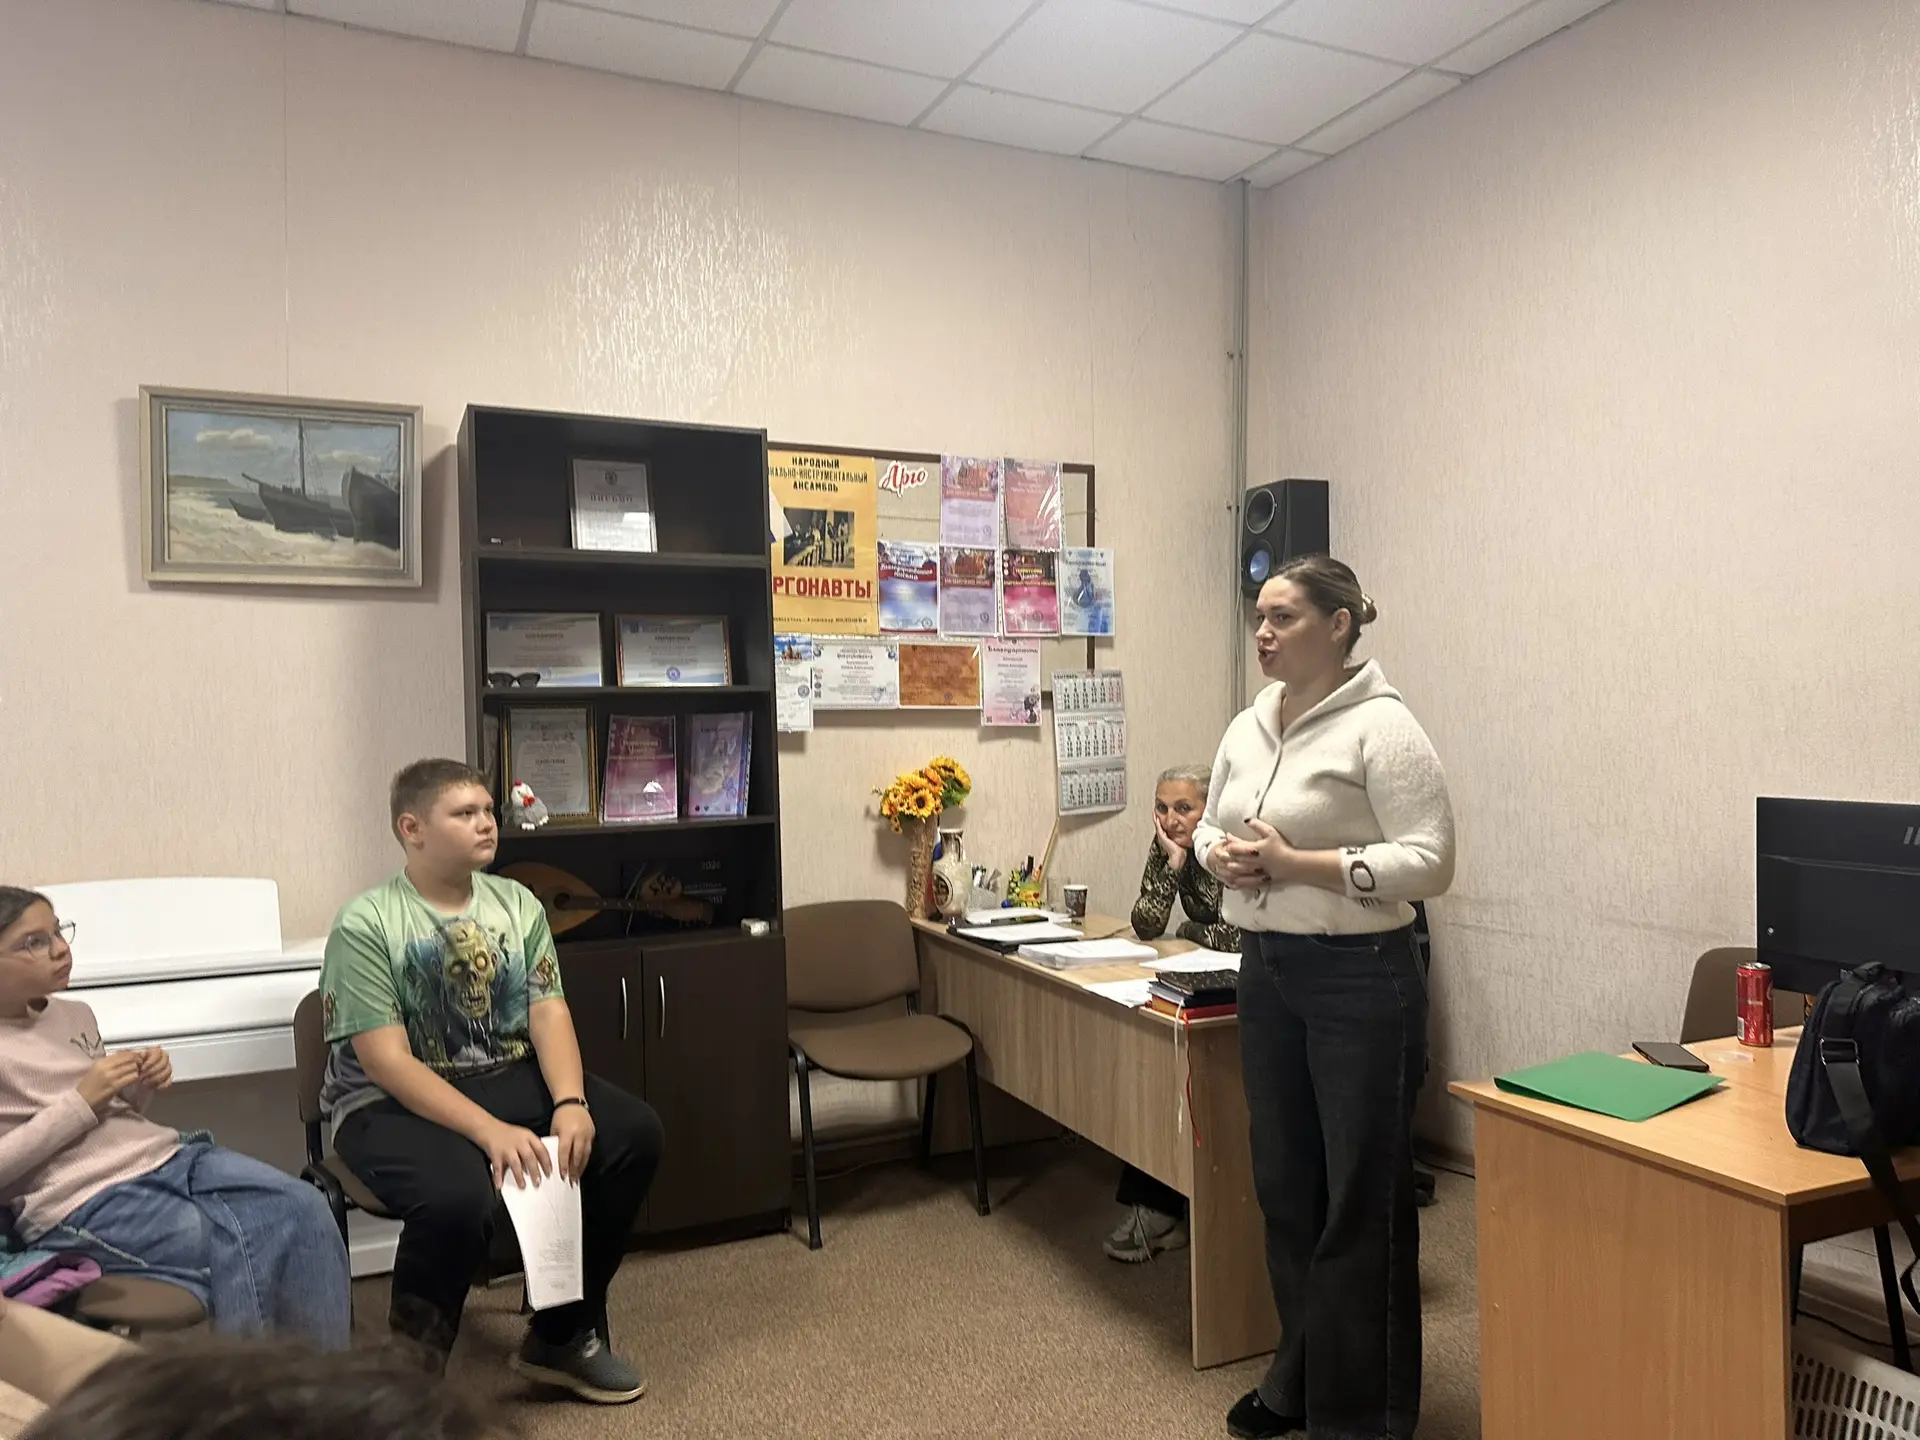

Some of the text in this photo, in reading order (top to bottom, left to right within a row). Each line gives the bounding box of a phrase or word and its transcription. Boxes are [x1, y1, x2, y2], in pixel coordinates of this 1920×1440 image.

[791, 456, 840, 469] НАРОДНЫЙ
[769, 466, 868, 484] КАЛЬНО-ИНСТРУМЕНТАЛЬНЫЙ
[792, 480, 839, 493] АНСАМБЛЬ
[773, 575, 872, 599] РГОНАВТЫ
